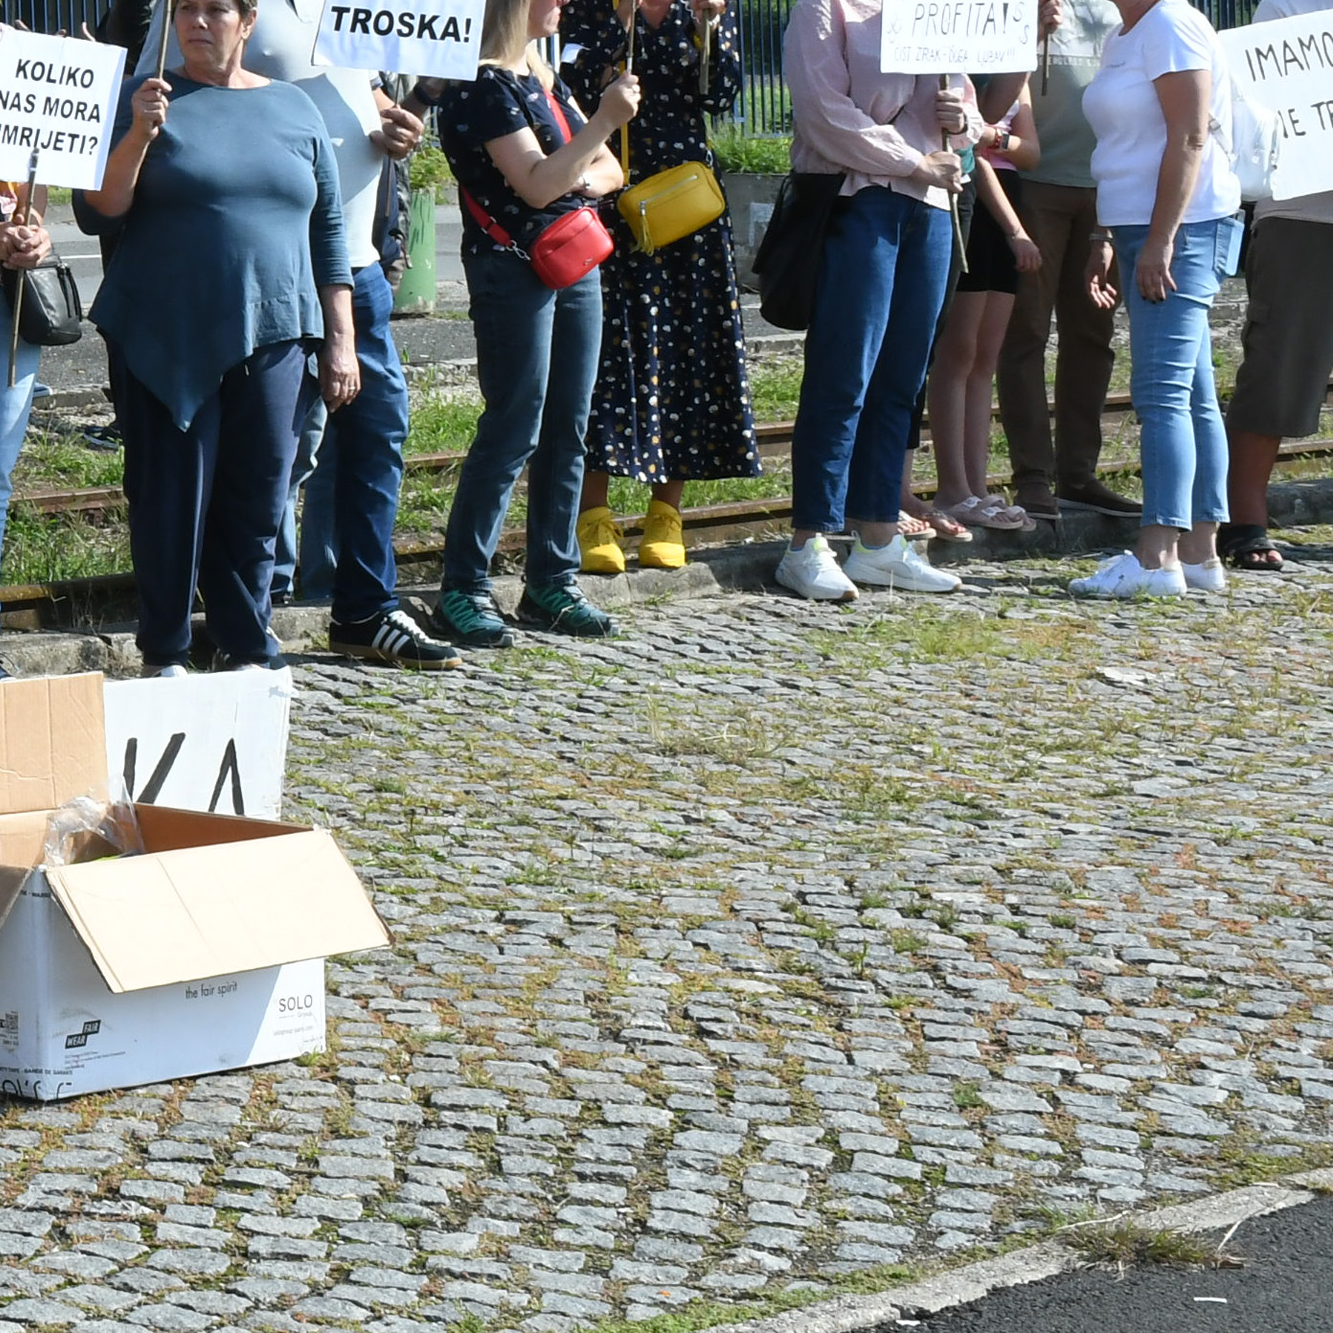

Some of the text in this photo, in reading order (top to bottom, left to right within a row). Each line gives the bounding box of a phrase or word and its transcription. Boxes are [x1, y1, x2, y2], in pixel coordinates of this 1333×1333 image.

[331, 5, 471, 44] TROSKA!
[912, 2, 1009, 37] PROFITA!
[16, 58, 95, 89] KOLIKO
[42, 95, 101, 124] MORA
[185, 980, 238, 999] the fair spirit
[279, 994, 313, 1012] SOLO
[66, 1035, 86, 1048] WEAR
